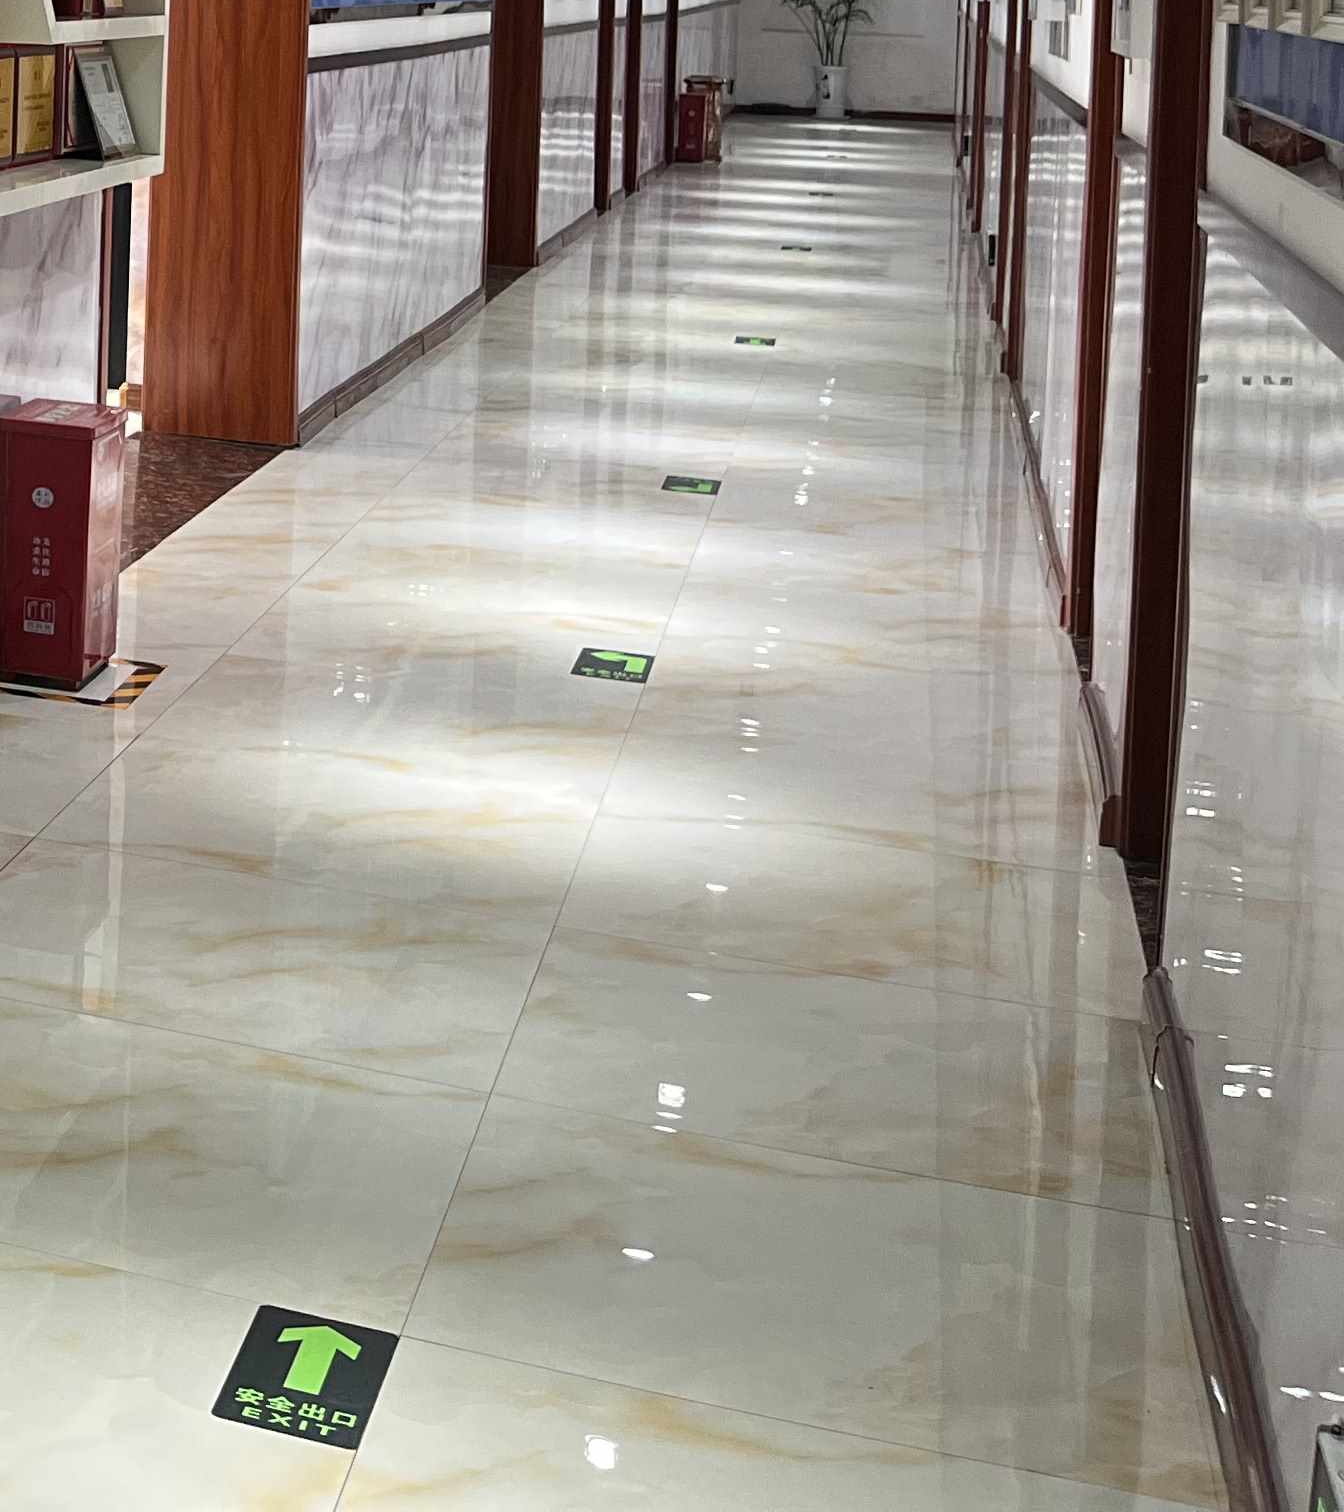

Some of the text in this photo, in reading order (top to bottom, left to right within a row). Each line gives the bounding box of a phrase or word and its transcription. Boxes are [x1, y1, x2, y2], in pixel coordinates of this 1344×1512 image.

[235, 1386, 358, 1428] 安全出口
[241, 1406, 337, 1437] EXIT
